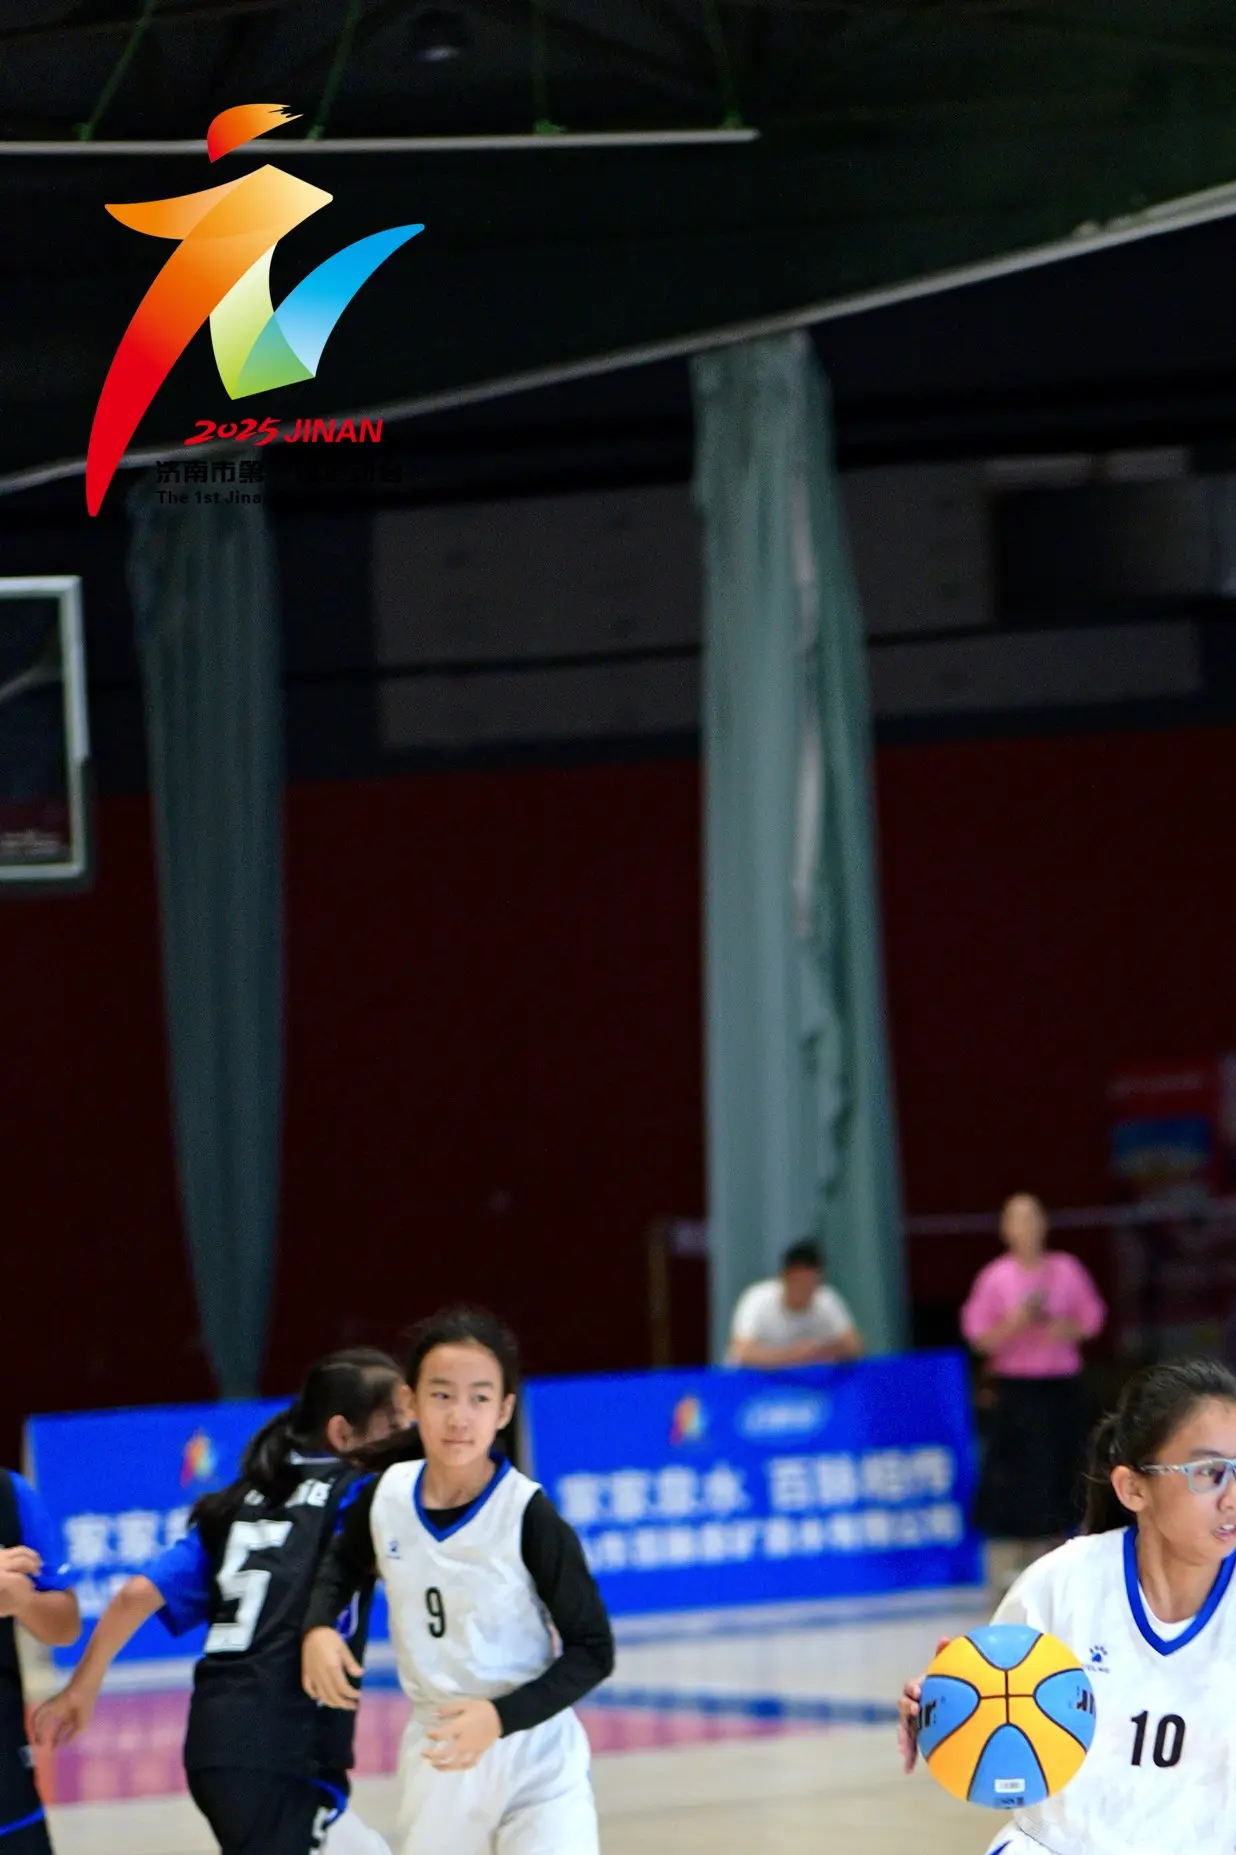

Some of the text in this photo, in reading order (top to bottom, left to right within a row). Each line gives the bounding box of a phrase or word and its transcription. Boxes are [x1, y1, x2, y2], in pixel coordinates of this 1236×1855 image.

[204, 1519, 293, 1653] 5
[424, 1586, 447, 1639] 9
[1129, 1708, 1186, 1769] 10
